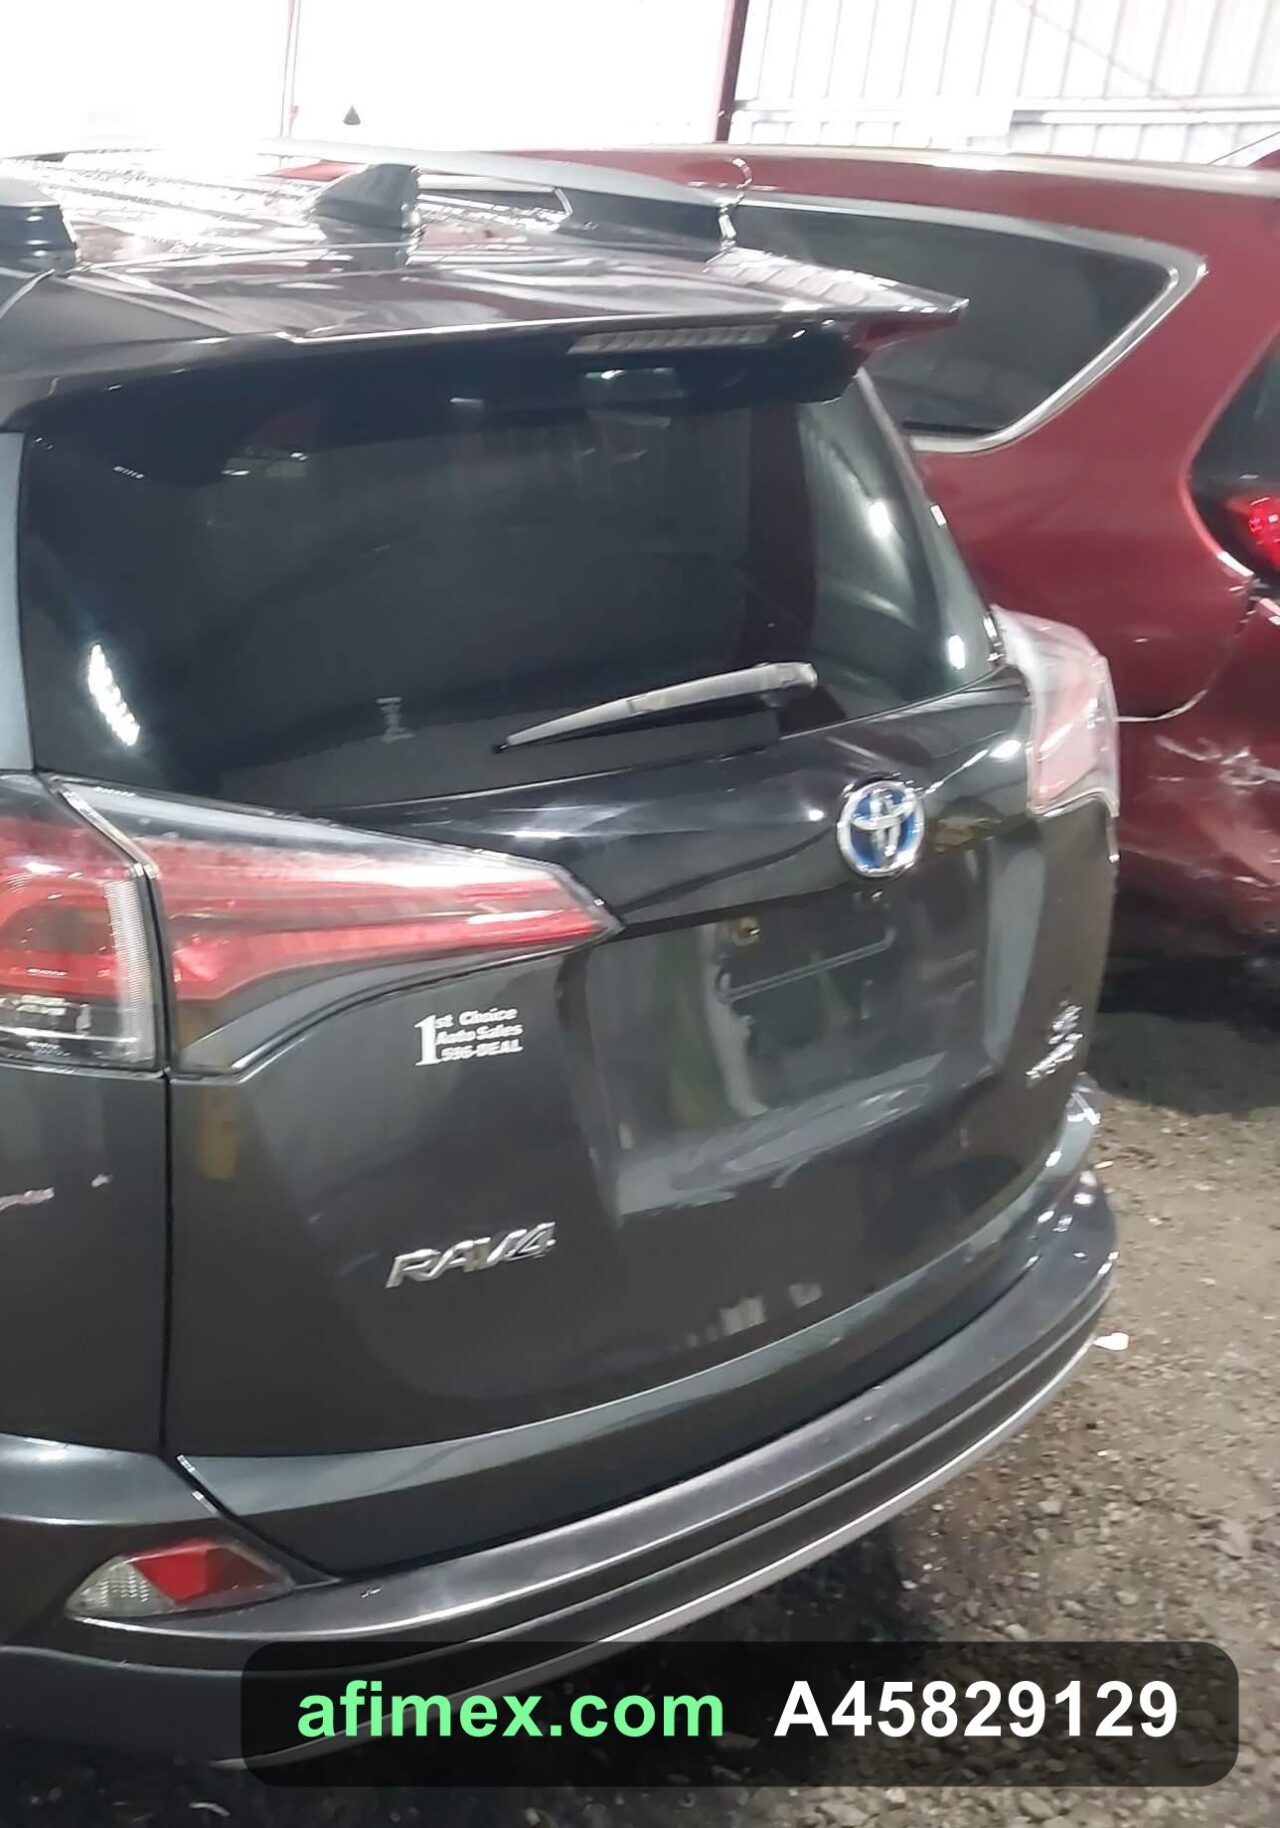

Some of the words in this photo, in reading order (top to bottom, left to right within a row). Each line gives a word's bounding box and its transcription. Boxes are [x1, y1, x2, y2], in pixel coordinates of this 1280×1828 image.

[414, 1014, 454, 1066] 1st
[459, 1007, 518, 1026] Choice
[436, 1029, 476, 1045] Auto
[476, 1023, 524, 1041] Sales
[384, 1221, 557, 1289] RAV4
